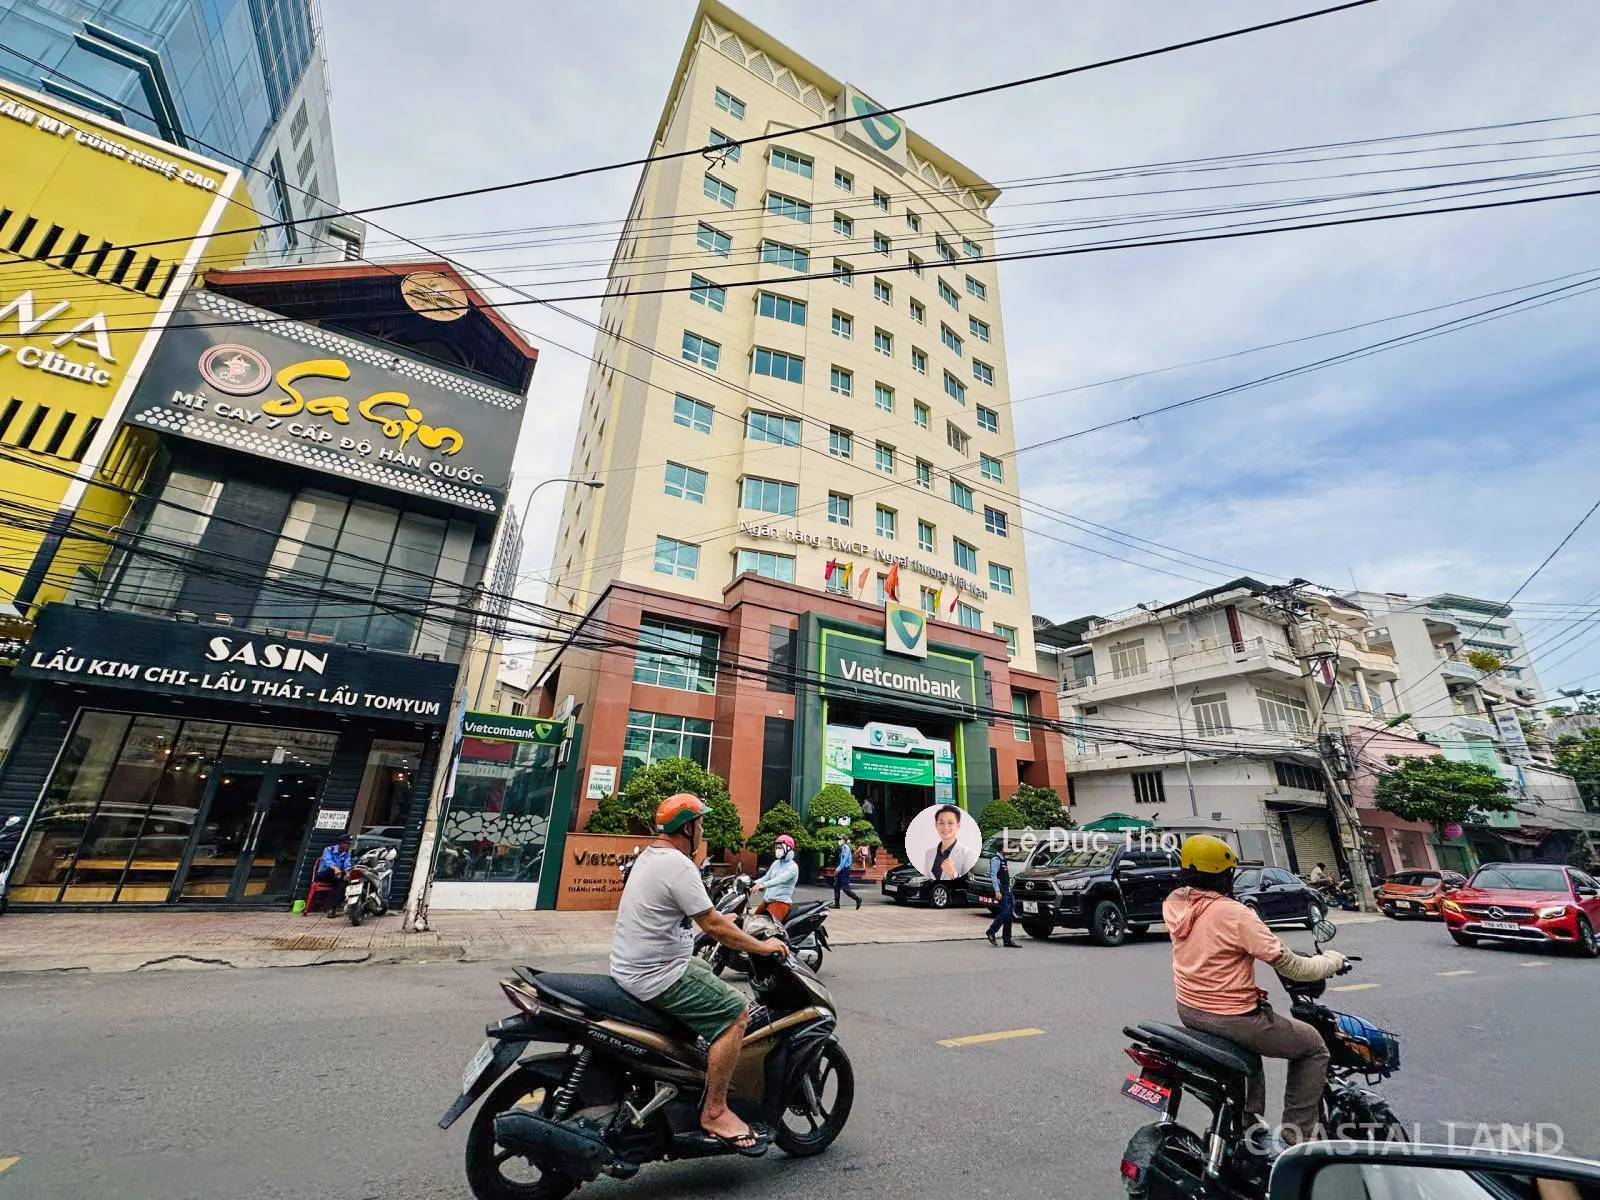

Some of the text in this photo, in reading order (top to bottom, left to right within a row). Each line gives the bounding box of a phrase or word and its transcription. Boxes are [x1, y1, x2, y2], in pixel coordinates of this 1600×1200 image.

[180, 168, 217, 190] CAO
[16, 346, 112, 387] Clinic
[171, 390, 485, 486] MÌ CAY 7 CẤP ĐỘ HÀN QUỐC
[740, 519, 780, 538] Ngân
[785, 527, 822, 548] hàng
[827, 536, 870, 554] TMCP
[204, 636, 329, 676] SASIN
[87, 658, 141, 680] KIM
[251, 678, 304, 700] THÁI
[364, 693, 441, 716] TOMYUM
[839, 658, 962, 699] Vietcombank
[464, 721, 536, 739] Vietcombank
